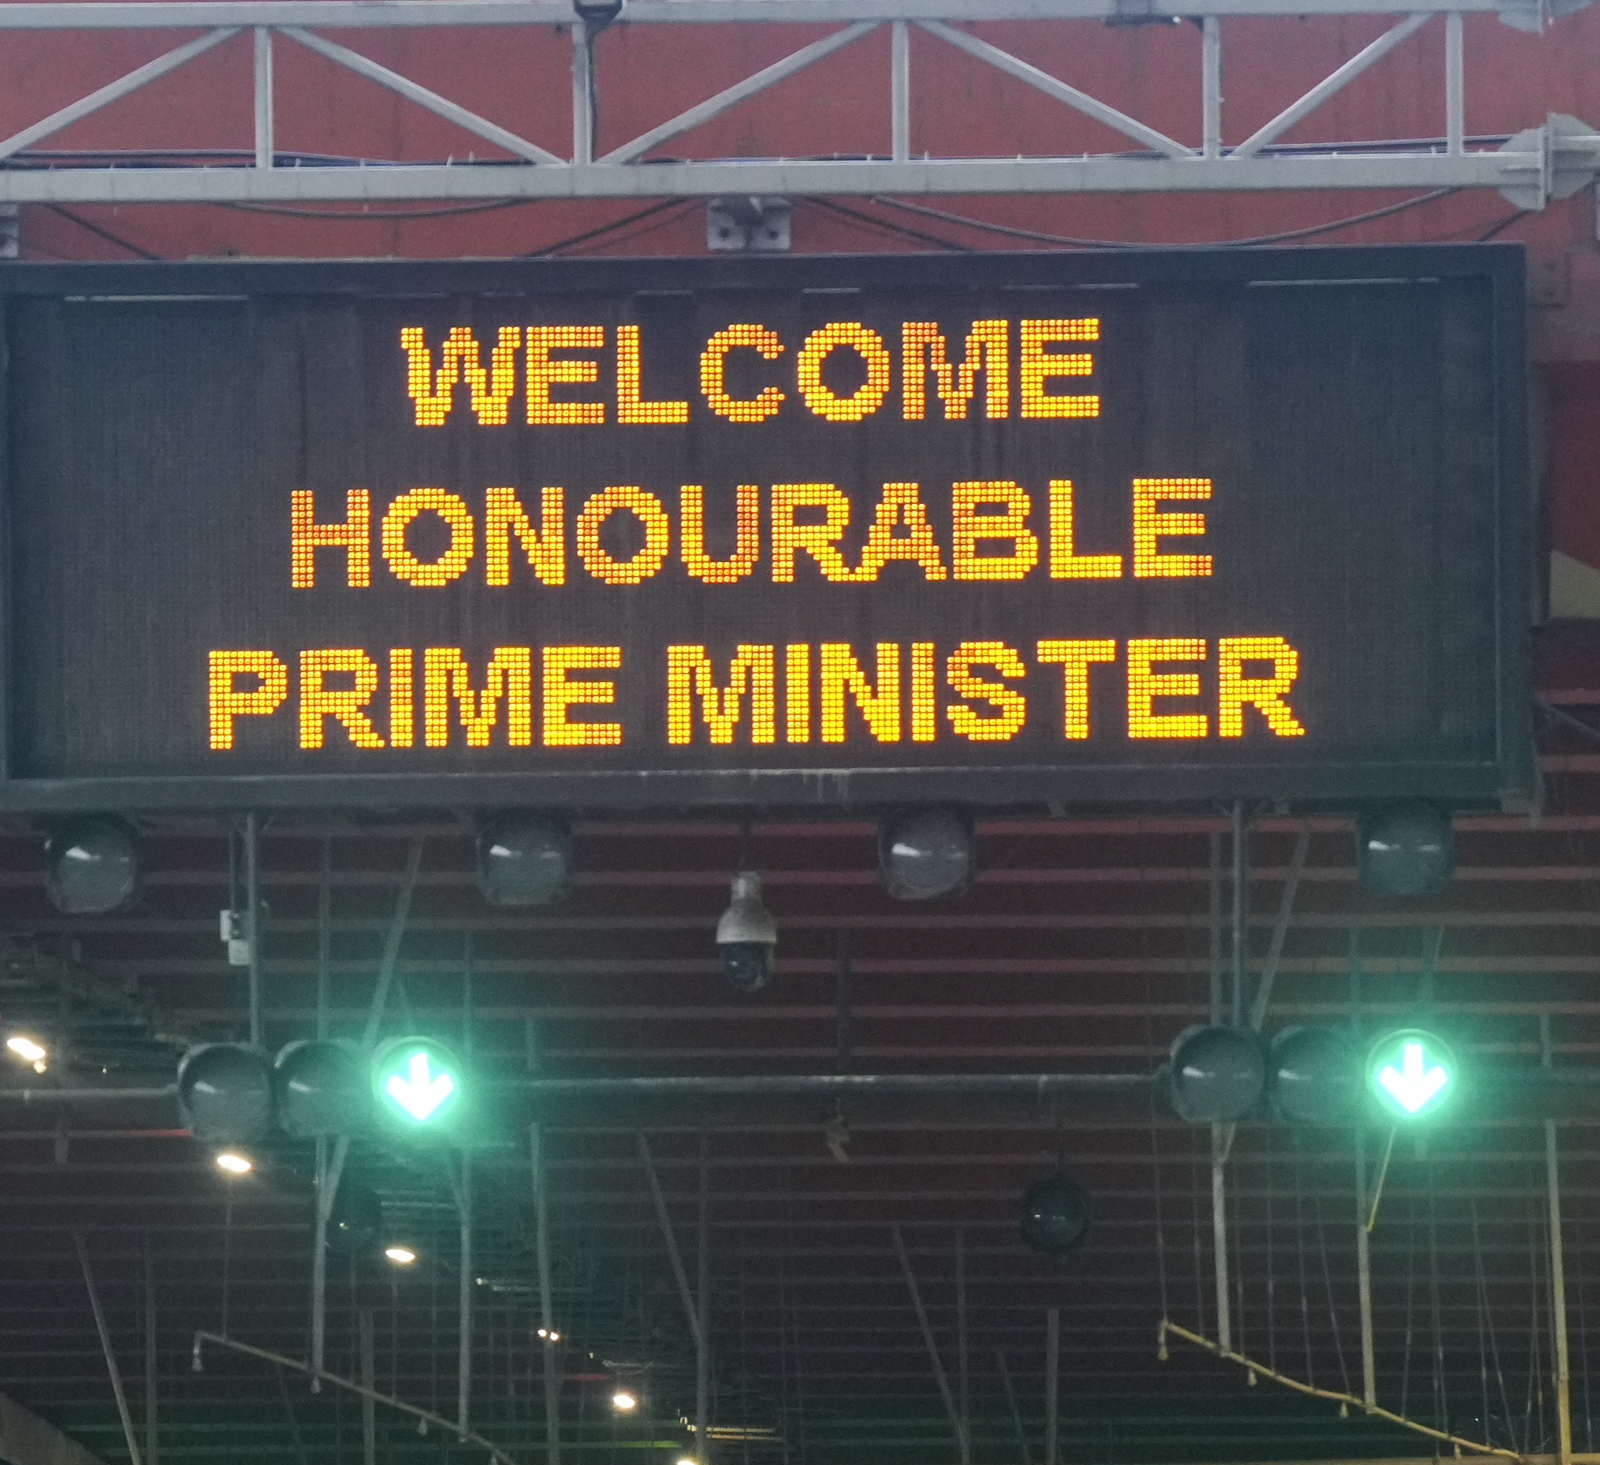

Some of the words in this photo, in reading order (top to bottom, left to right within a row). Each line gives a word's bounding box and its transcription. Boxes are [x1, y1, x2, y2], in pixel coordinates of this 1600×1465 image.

[401, 318, 1099, 426] WELCOME
[291, 478, 1212, 588] HONOURABLE
[209, 645, 622, 749] PRIME
[667, 637, 1305, 744] MINISTER
